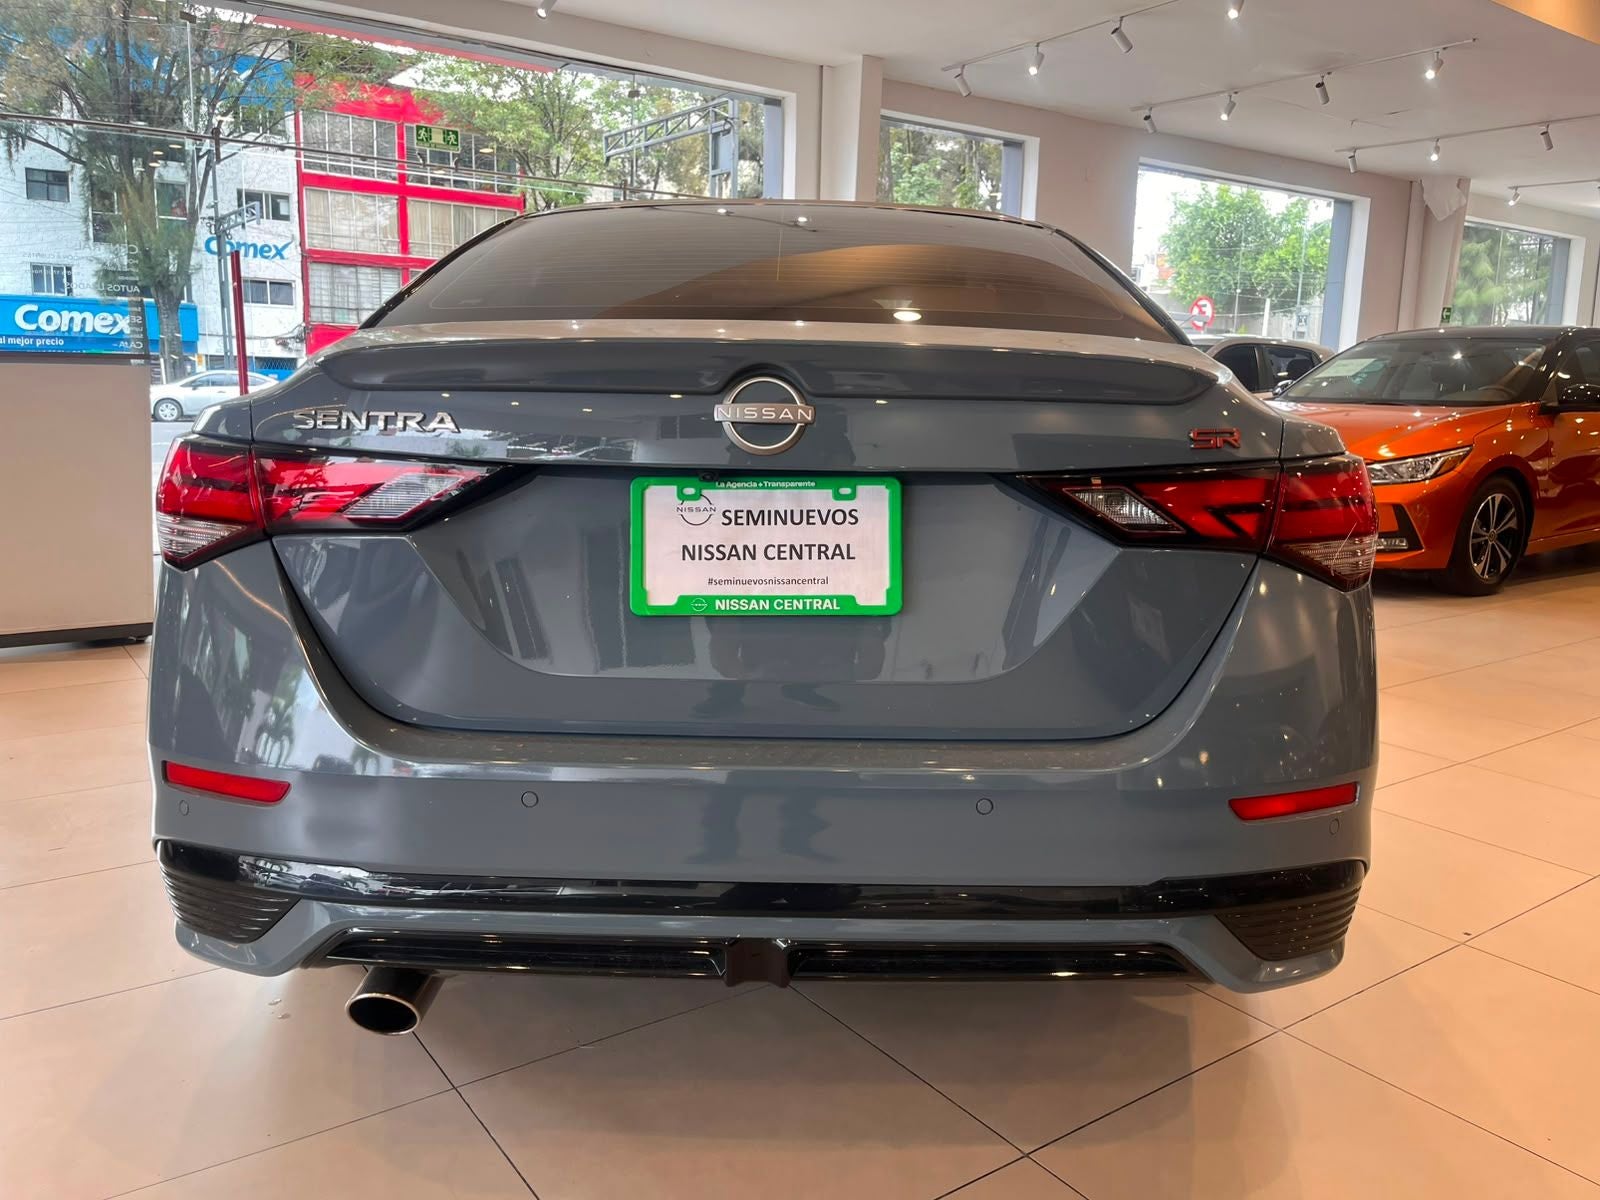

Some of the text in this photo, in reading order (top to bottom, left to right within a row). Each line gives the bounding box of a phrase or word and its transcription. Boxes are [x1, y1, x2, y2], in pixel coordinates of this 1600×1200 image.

[14, 303, 132, 335] Comex
[8, 336, 34, 347] mejor
[36, 337, 65, 348] precio
[293, 409, 461, 434] SENTRA
[717, 406, 813, 421] NISSAN
[1188, 427, 1241, 450] SR
[726, 481, 757, 489] Agencia
[721, 508, 859, 527] SEMINUEVOS
[681, 543, 856, 561] NISSAN CENTRAL
[707, 576, 829, 586] #seminuevosnissancentral
[715, 599, 770, 611] NISSAN
[773, 598, 841, 611] CENTRAL
